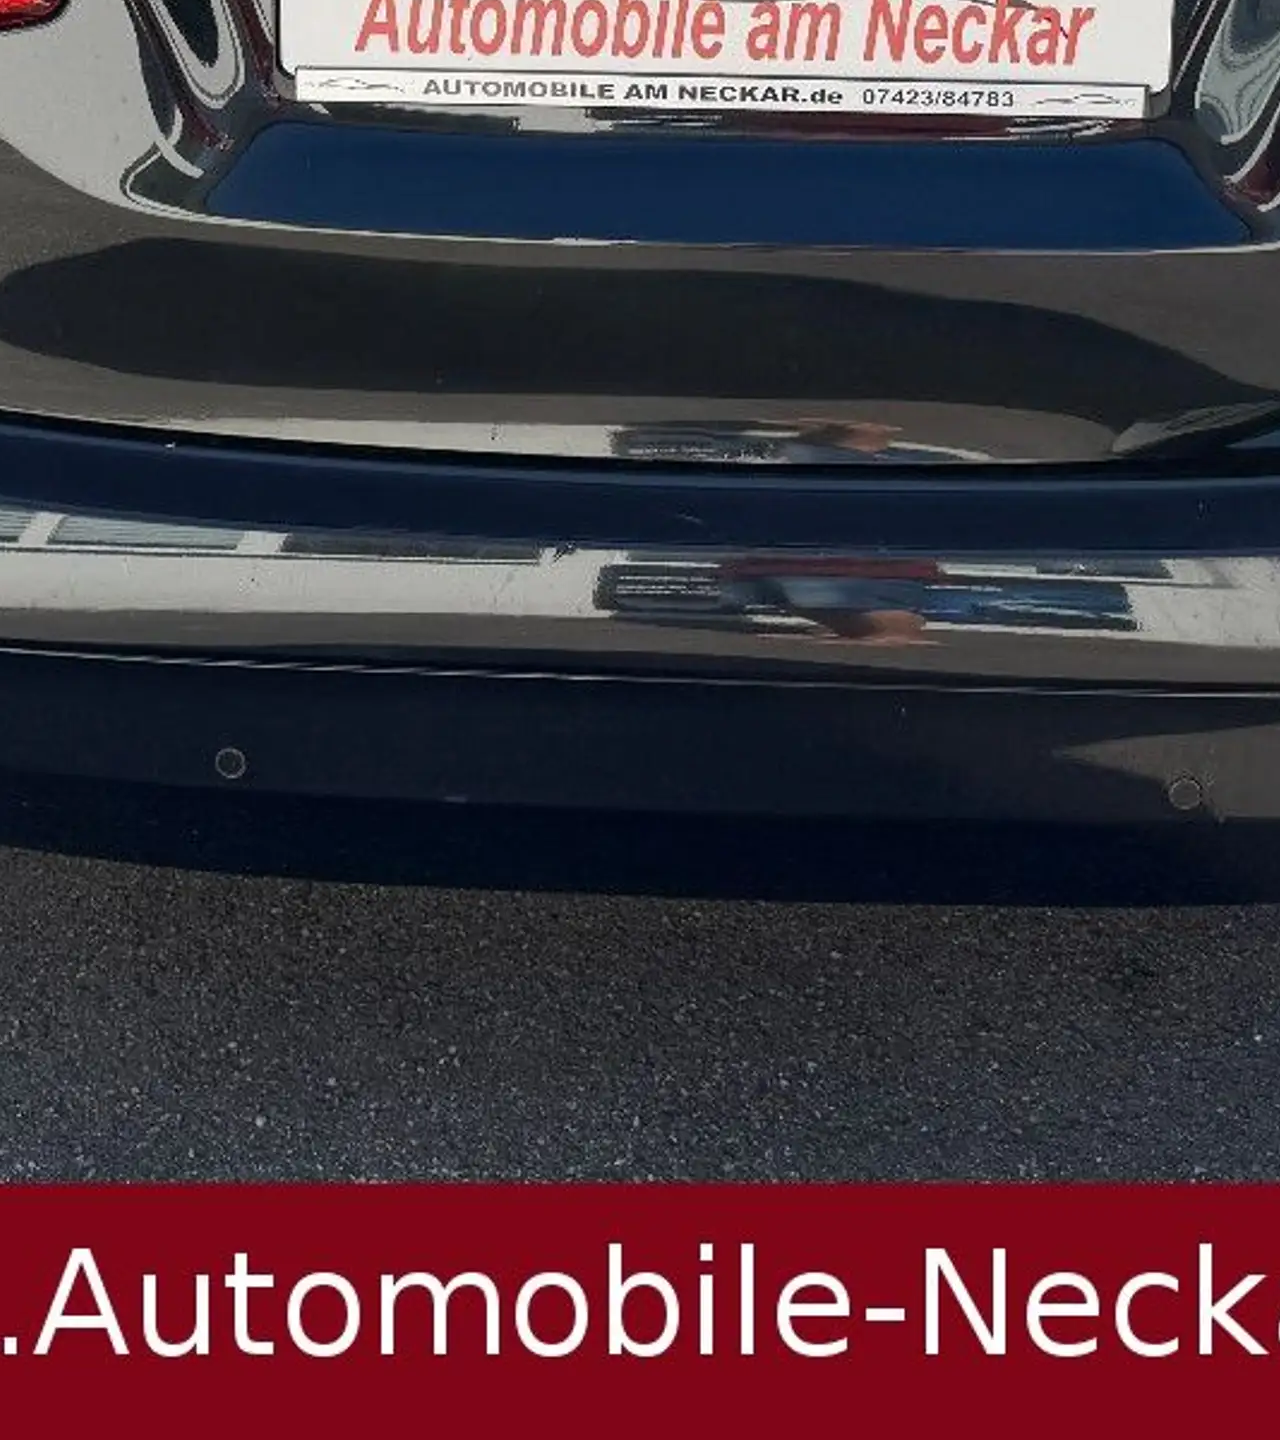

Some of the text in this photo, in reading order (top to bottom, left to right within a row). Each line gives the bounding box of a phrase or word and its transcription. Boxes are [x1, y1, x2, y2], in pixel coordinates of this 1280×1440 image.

[745, 0, 842, 61] am
[422, 78, 1015, 108] AUTOMOBILE AM NECKAR.de 07423/84783
